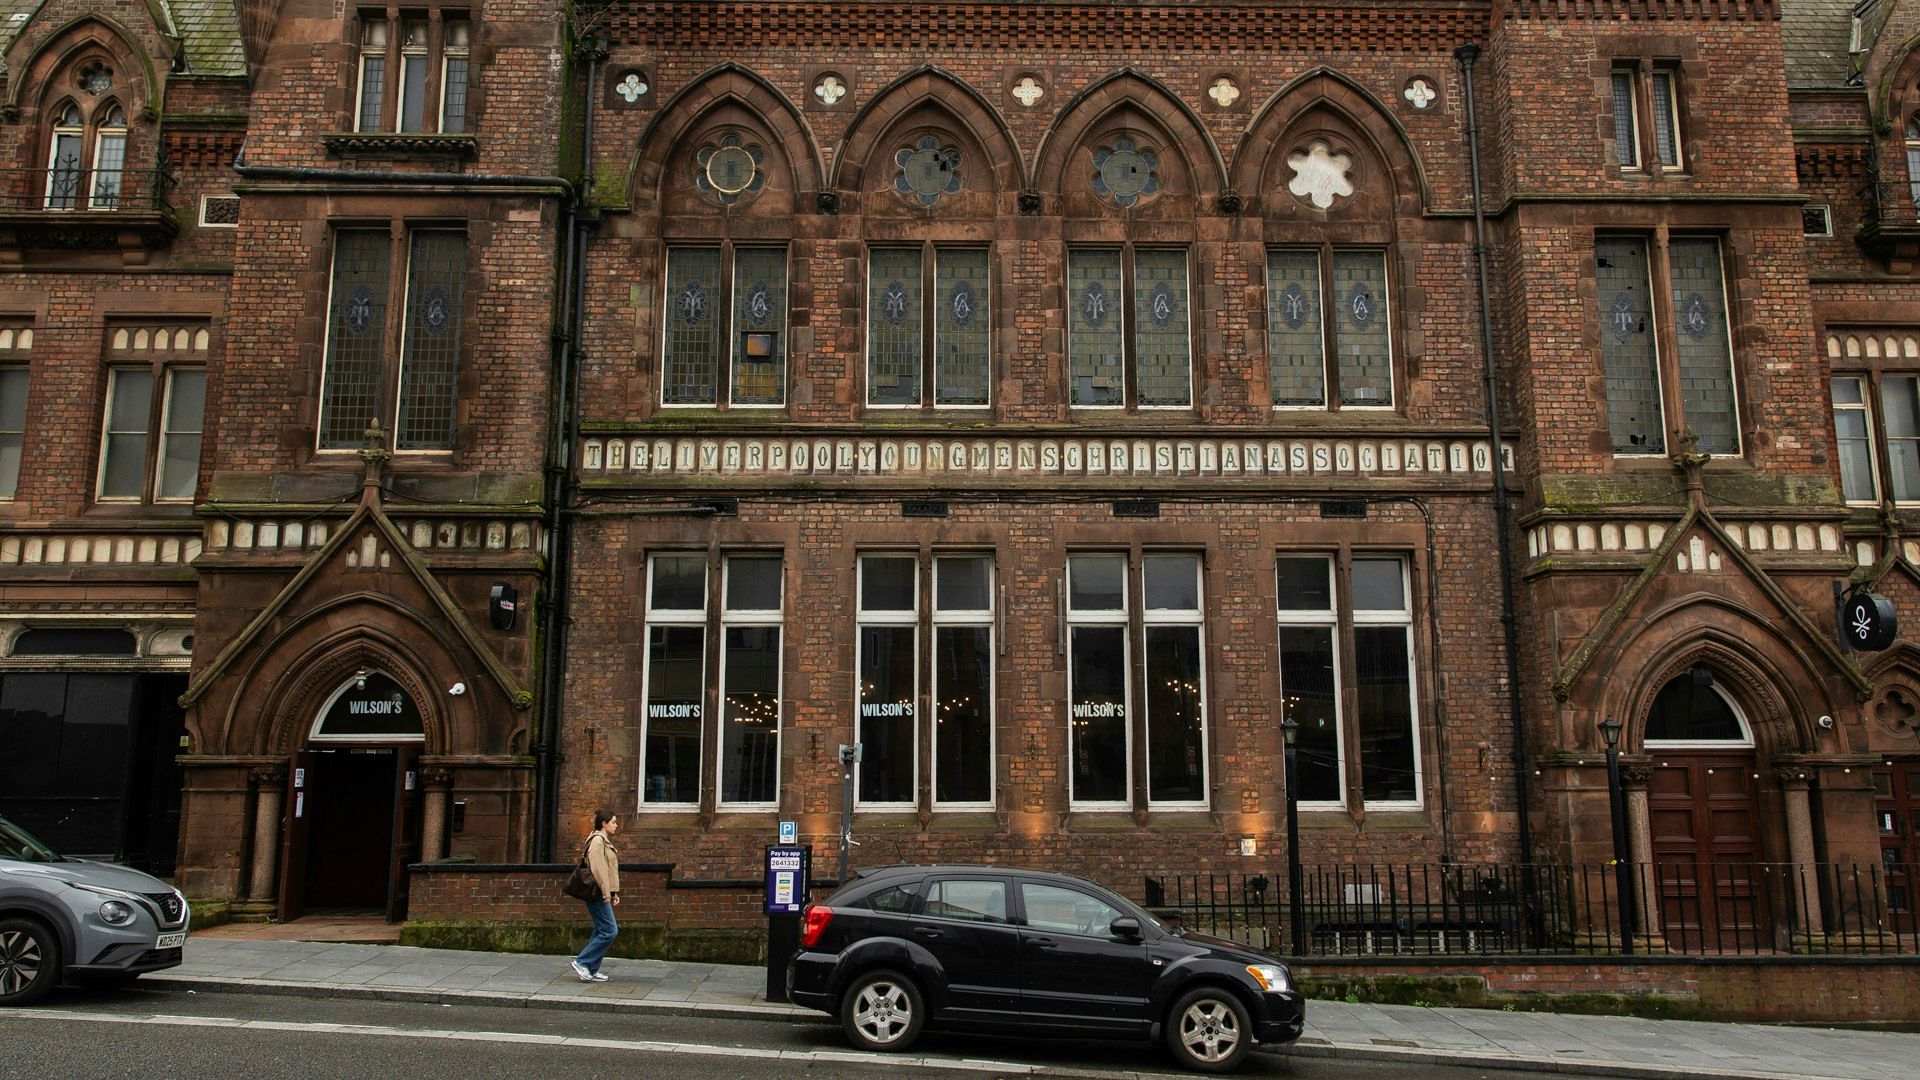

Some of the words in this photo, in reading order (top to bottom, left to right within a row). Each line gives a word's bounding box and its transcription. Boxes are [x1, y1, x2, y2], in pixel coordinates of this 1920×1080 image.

[349, 700, 402, 714] WILSON'S
[649, 704, 701, 718] WILSON'S
[861, 702, 914, 717] WILSON'S
[1073, 703, 1125, 717] WILSON'S
[783, 823, 792, 835] P
